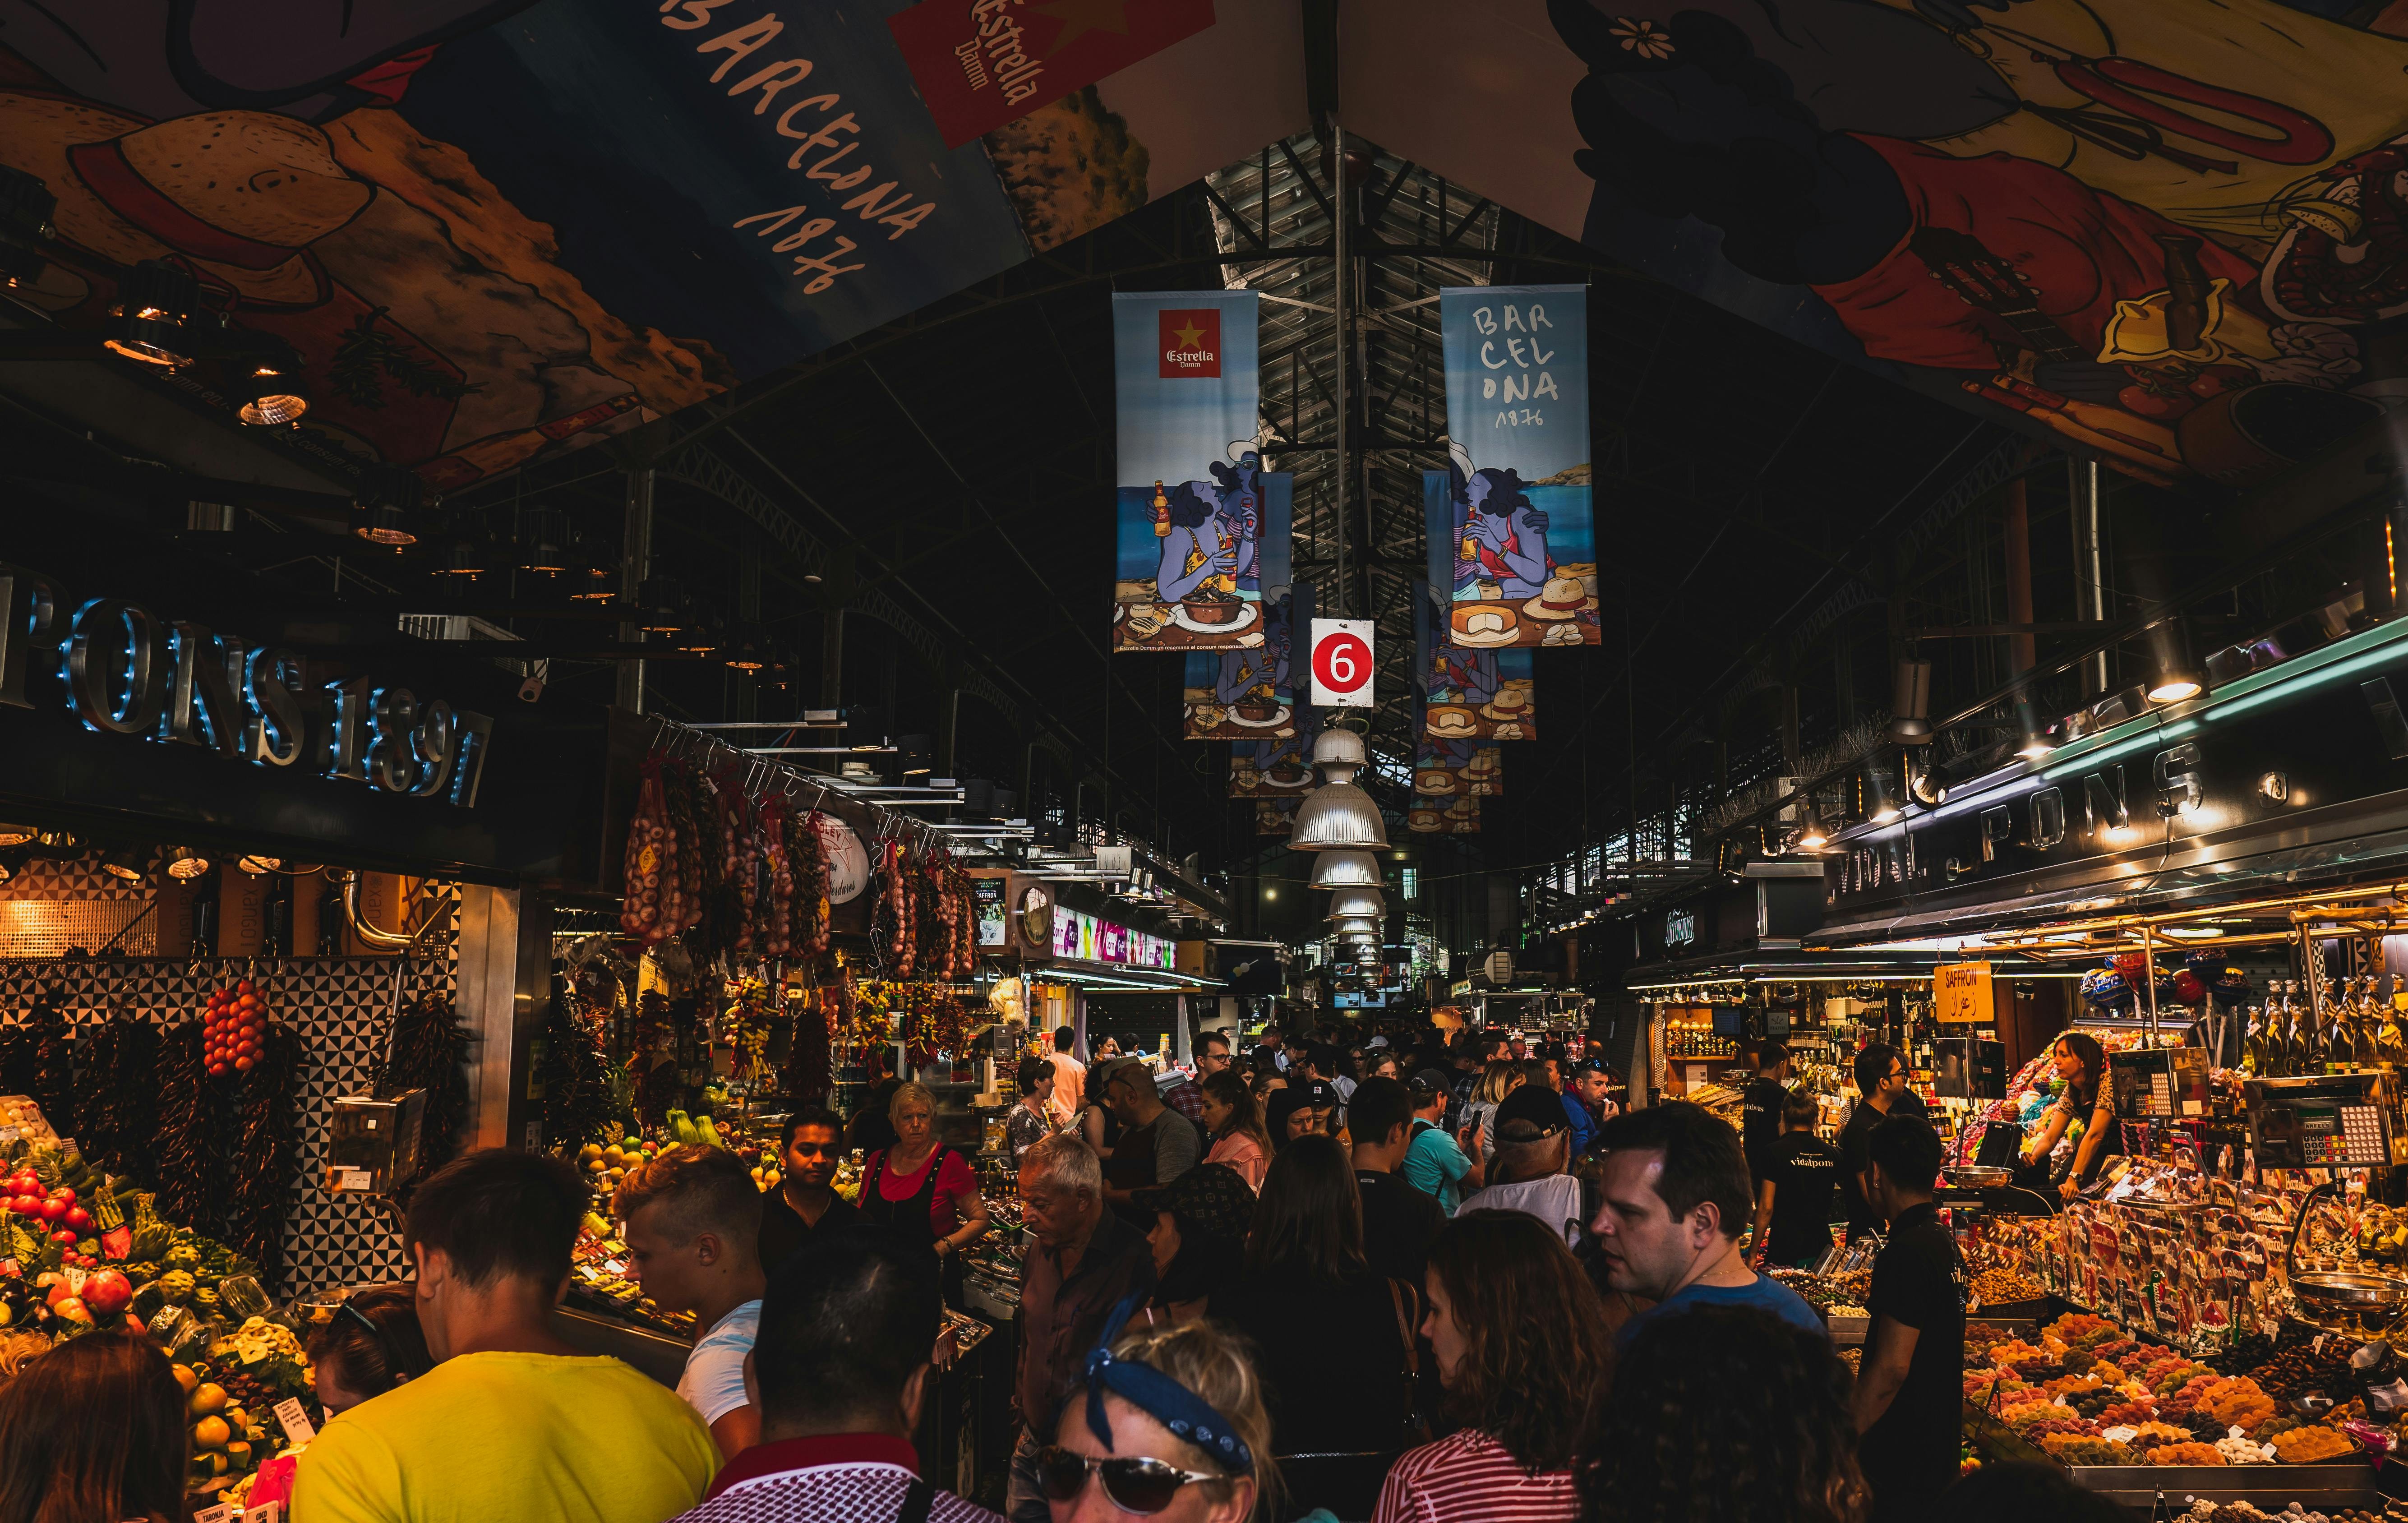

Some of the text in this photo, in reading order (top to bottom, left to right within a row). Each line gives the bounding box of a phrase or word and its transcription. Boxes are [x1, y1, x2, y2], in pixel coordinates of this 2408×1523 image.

[953, 36, 992, 92] Damm
[733, 205, 866, 295] 1876
[1472, 304, 1553, 335] BAR
[1167, 349, 1213, 362] Estrella
[1481, 337, 1554, 369] CEL
[1483, 371, 1559, 404] ONA
[1495, 408, 1543, 429] 1876
[0, 561, 305, 767] PONS
[1330, 643, 1355, 682] 6
[1980, 743, 2203, 862] PONS
[1069, 925, 1077, 942] Fruit
[1946, 968, 1977, 988] SAFFRON
[1790, 1157, 1834, 1168] vidalpons
[203, 1509, 224, 1523] TARONJA
